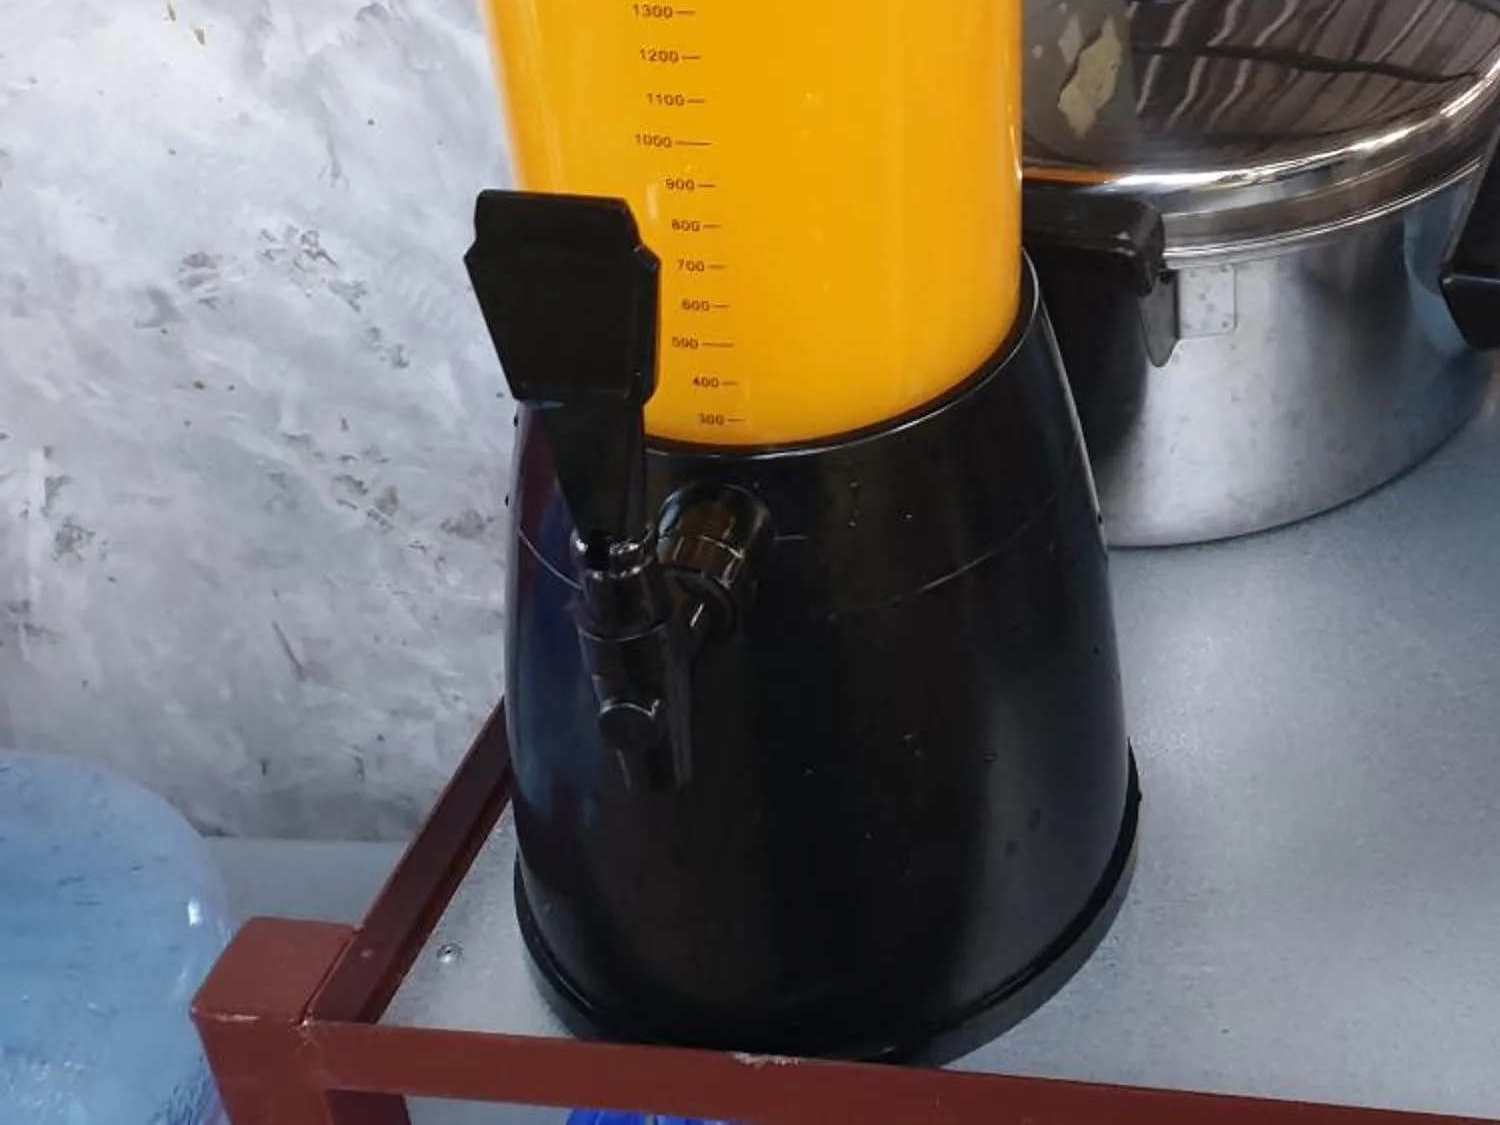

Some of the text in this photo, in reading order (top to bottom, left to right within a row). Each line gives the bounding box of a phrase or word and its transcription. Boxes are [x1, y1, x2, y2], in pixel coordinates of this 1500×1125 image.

[633, 4, 673, 18] 1300
[640, 48, 679, 64] 1200
[646, 92, 685, 106] 1100
[634, 133, 672, 148] 1000
[665, 178, 695, 191] 900
[671, 218, 701, 232] 800
[678, 258, 705, 272] 700
[681, 298, 710, 311] 600
[671, 336, 699, 349] 500
[692, 376, 719, 388] 400
[699, 413, 725, 425] 300
